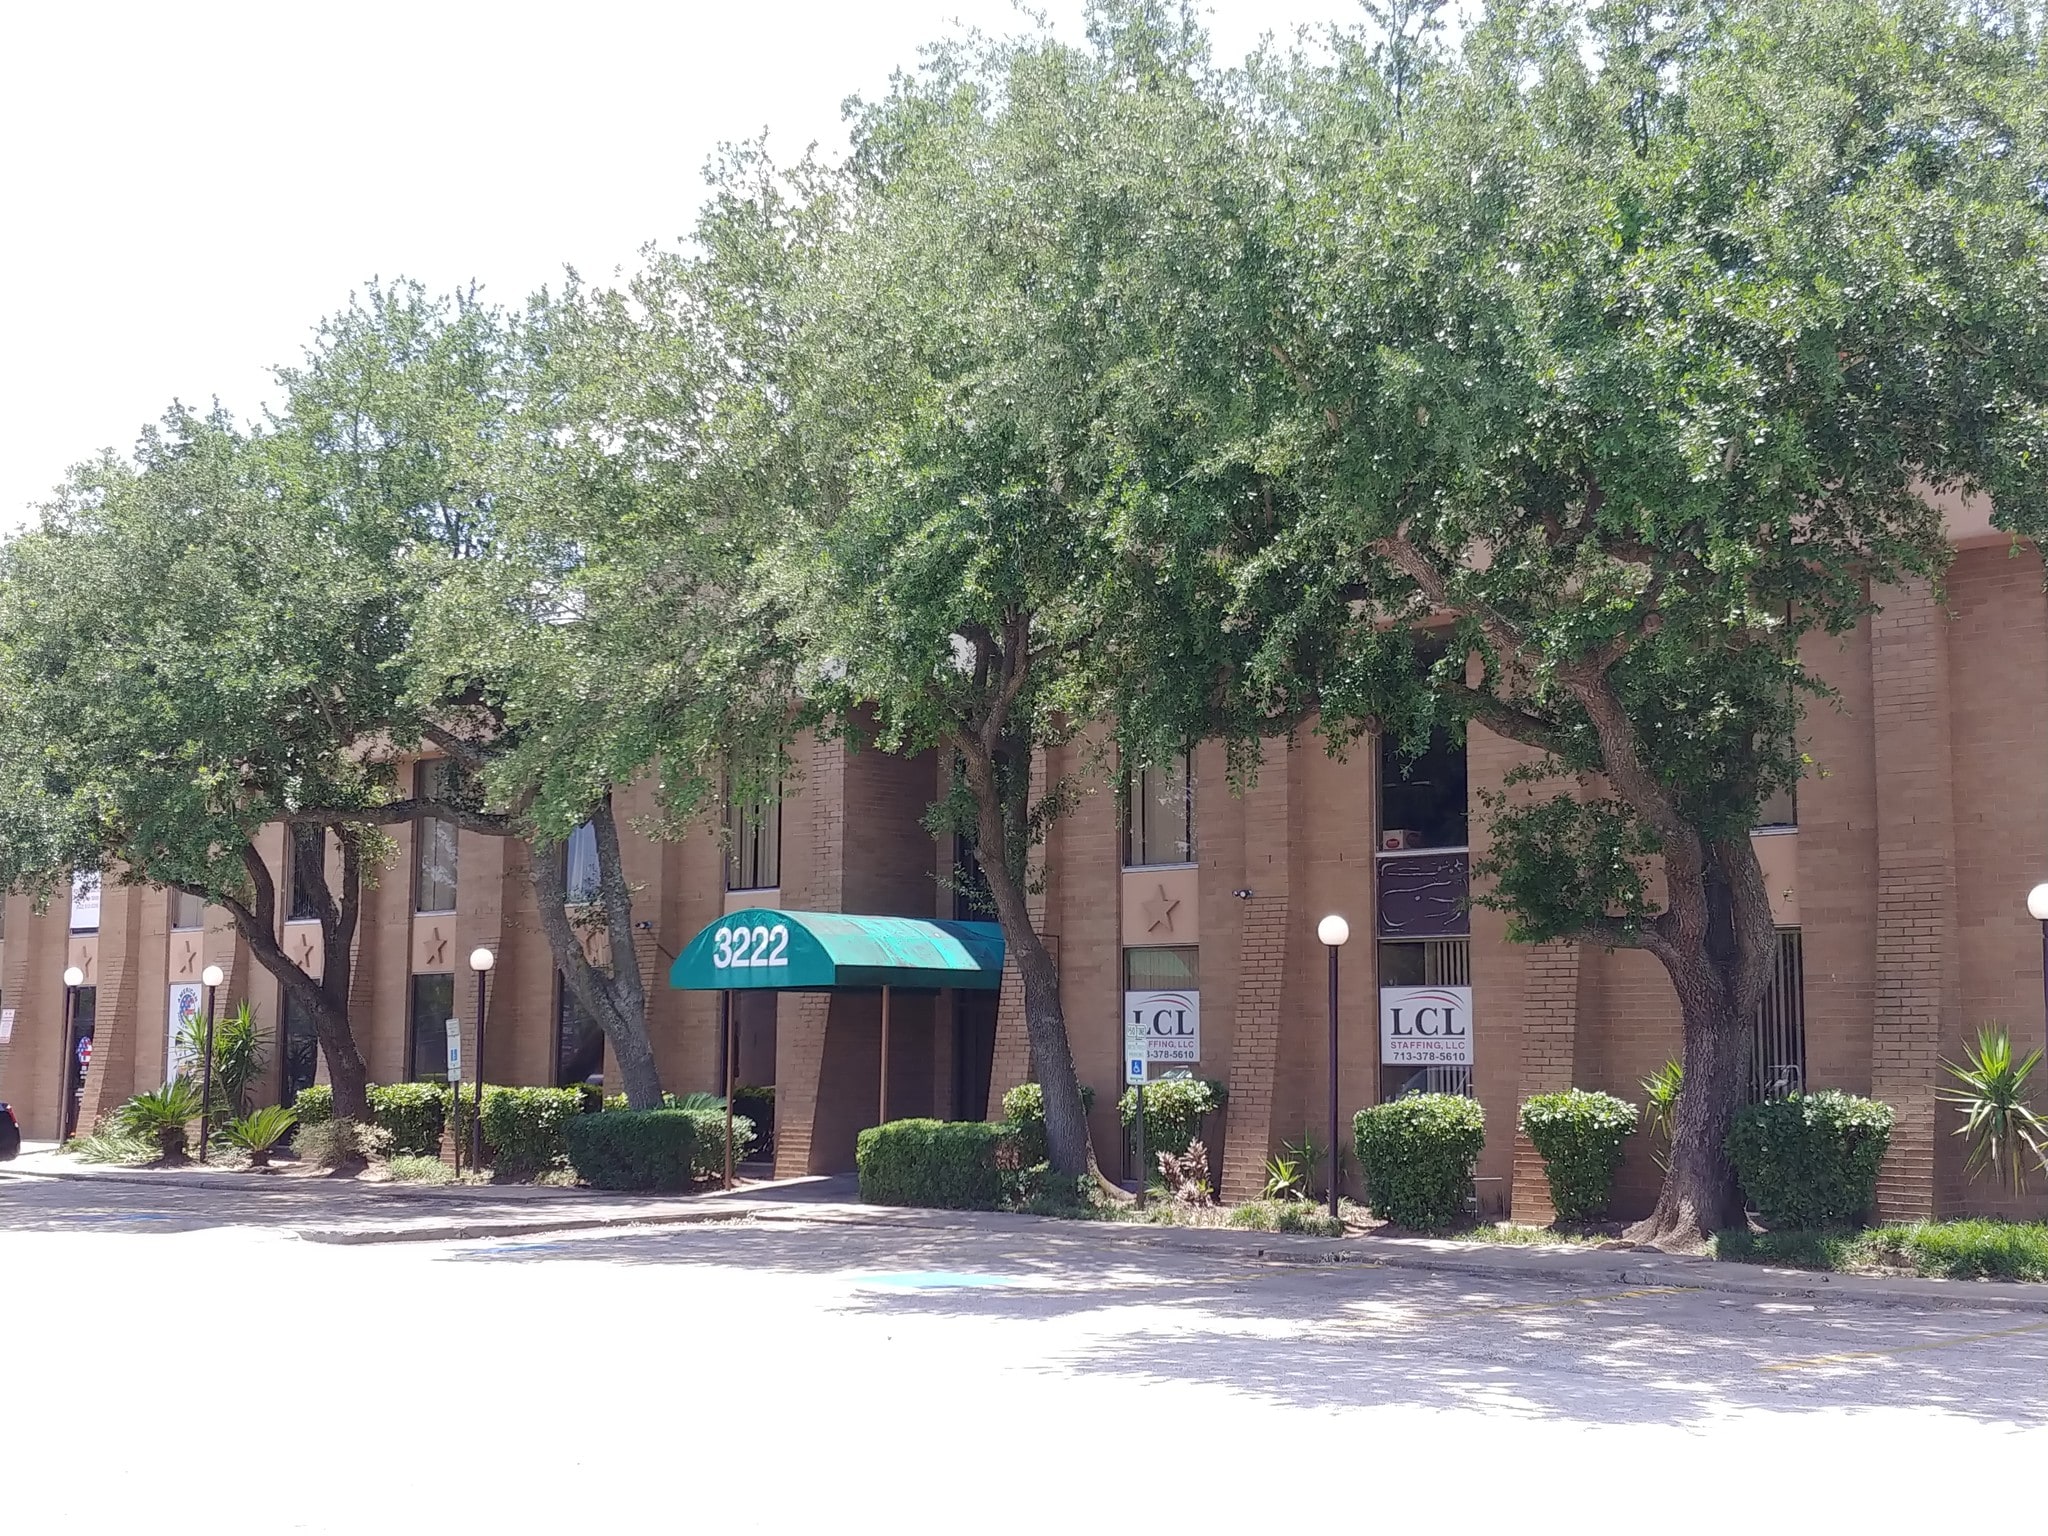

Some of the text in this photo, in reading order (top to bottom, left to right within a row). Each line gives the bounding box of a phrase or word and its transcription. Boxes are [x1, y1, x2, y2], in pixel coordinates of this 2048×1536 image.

[713, 924, 789, 969] 3222
[1132, 1009, 1194, 1036] LCL
[1390, 1007, 1466, 1036] LCL
[1148, 1040, 1177, 1049] FFING,
[1178, 1040, 1194, 1048] LLC
[1390, 1041, 1466, 1050] STAFFING, LLC
[1147, 1050, 1194, 1059] 3-378-5610
[1393, 1052, 1466, 1061] 713-378-5610
